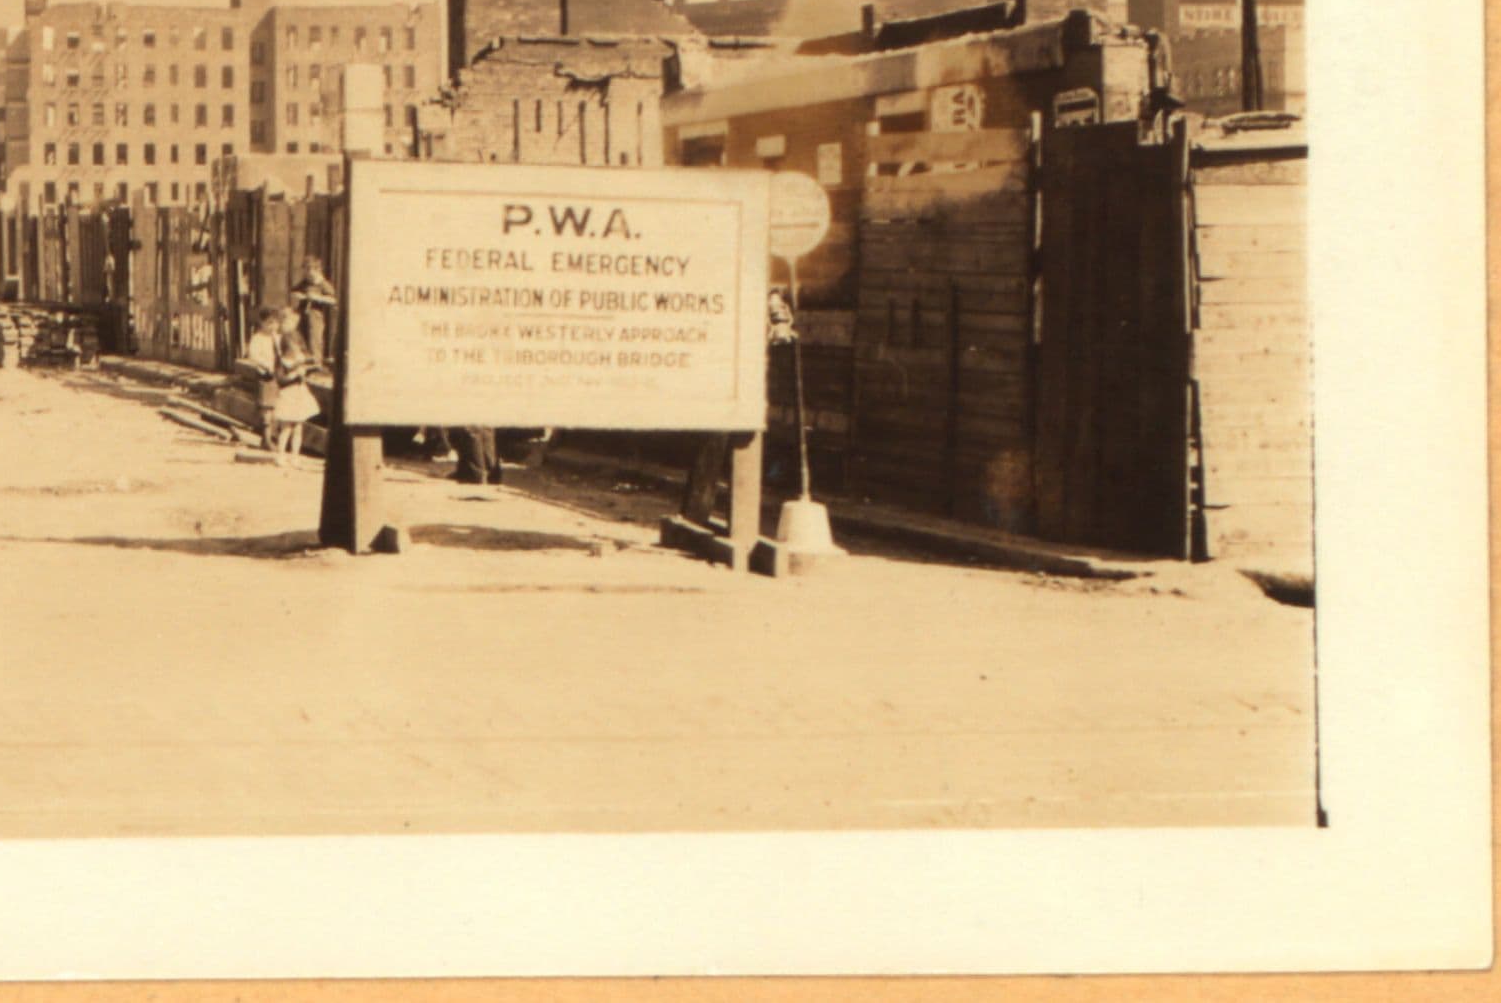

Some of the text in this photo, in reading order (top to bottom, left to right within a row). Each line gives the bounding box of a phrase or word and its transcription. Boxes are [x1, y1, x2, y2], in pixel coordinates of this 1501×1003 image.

[502, 203, 642, 240] P.W.A.
[425, 247, 691, 278] FEDERAL EMERGENCY
[387, 284, 725, 316] ADMINISTRATION OF PUBLIC WORKS
[517, 323, 616, 343] WESTERLY
[618, 326, 707, 344] APPROACH
[452, 348, 485, 365] THE
[617, 351, 692, 369] BRIDGE
